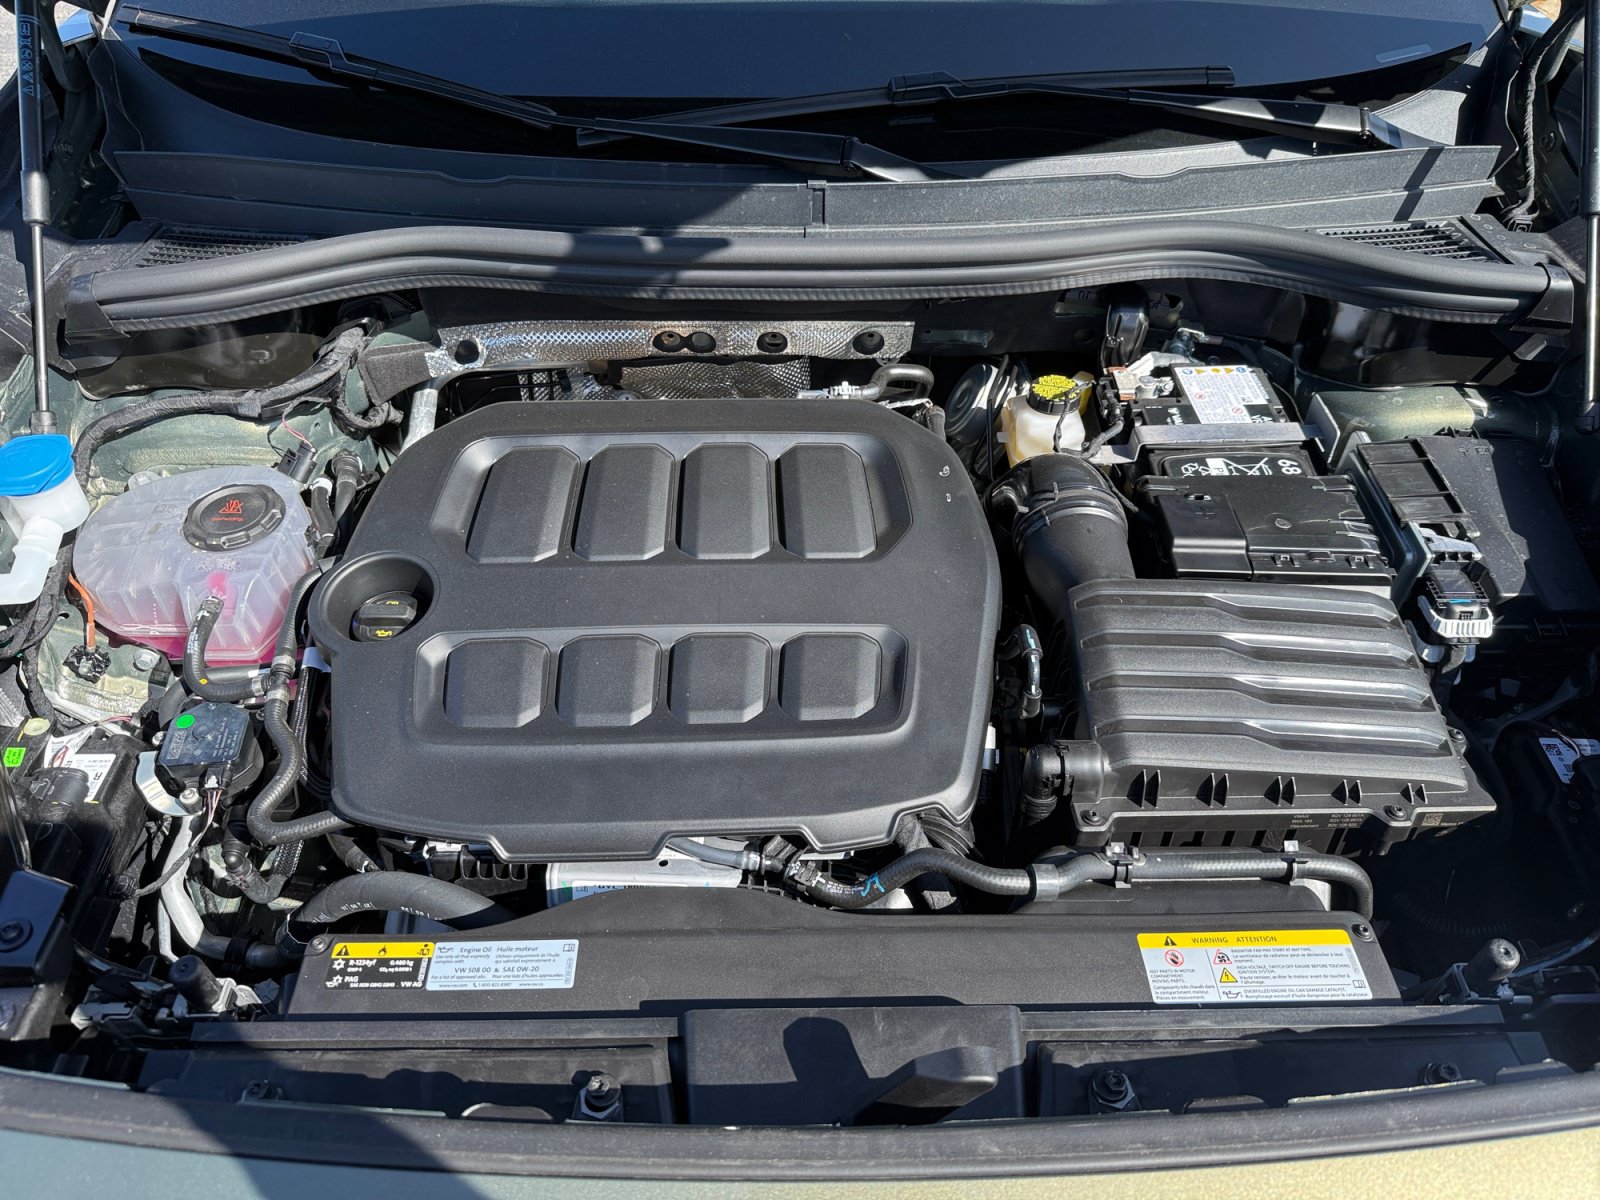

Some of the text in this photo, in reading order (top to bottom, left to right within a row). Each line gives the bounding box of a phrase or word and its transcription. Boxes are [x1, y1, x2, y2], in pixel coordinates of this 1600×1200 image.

[1277, 459, 1302, 475] 68
[1191, 935, 1278, 944] WARNING ATTENTION
[460, 946, 481, 954] Engine
[348, 959, 377, 967] R-1234yf
[407, 959, 415, 967] kg
[344, 975, 359, 983] PAG
